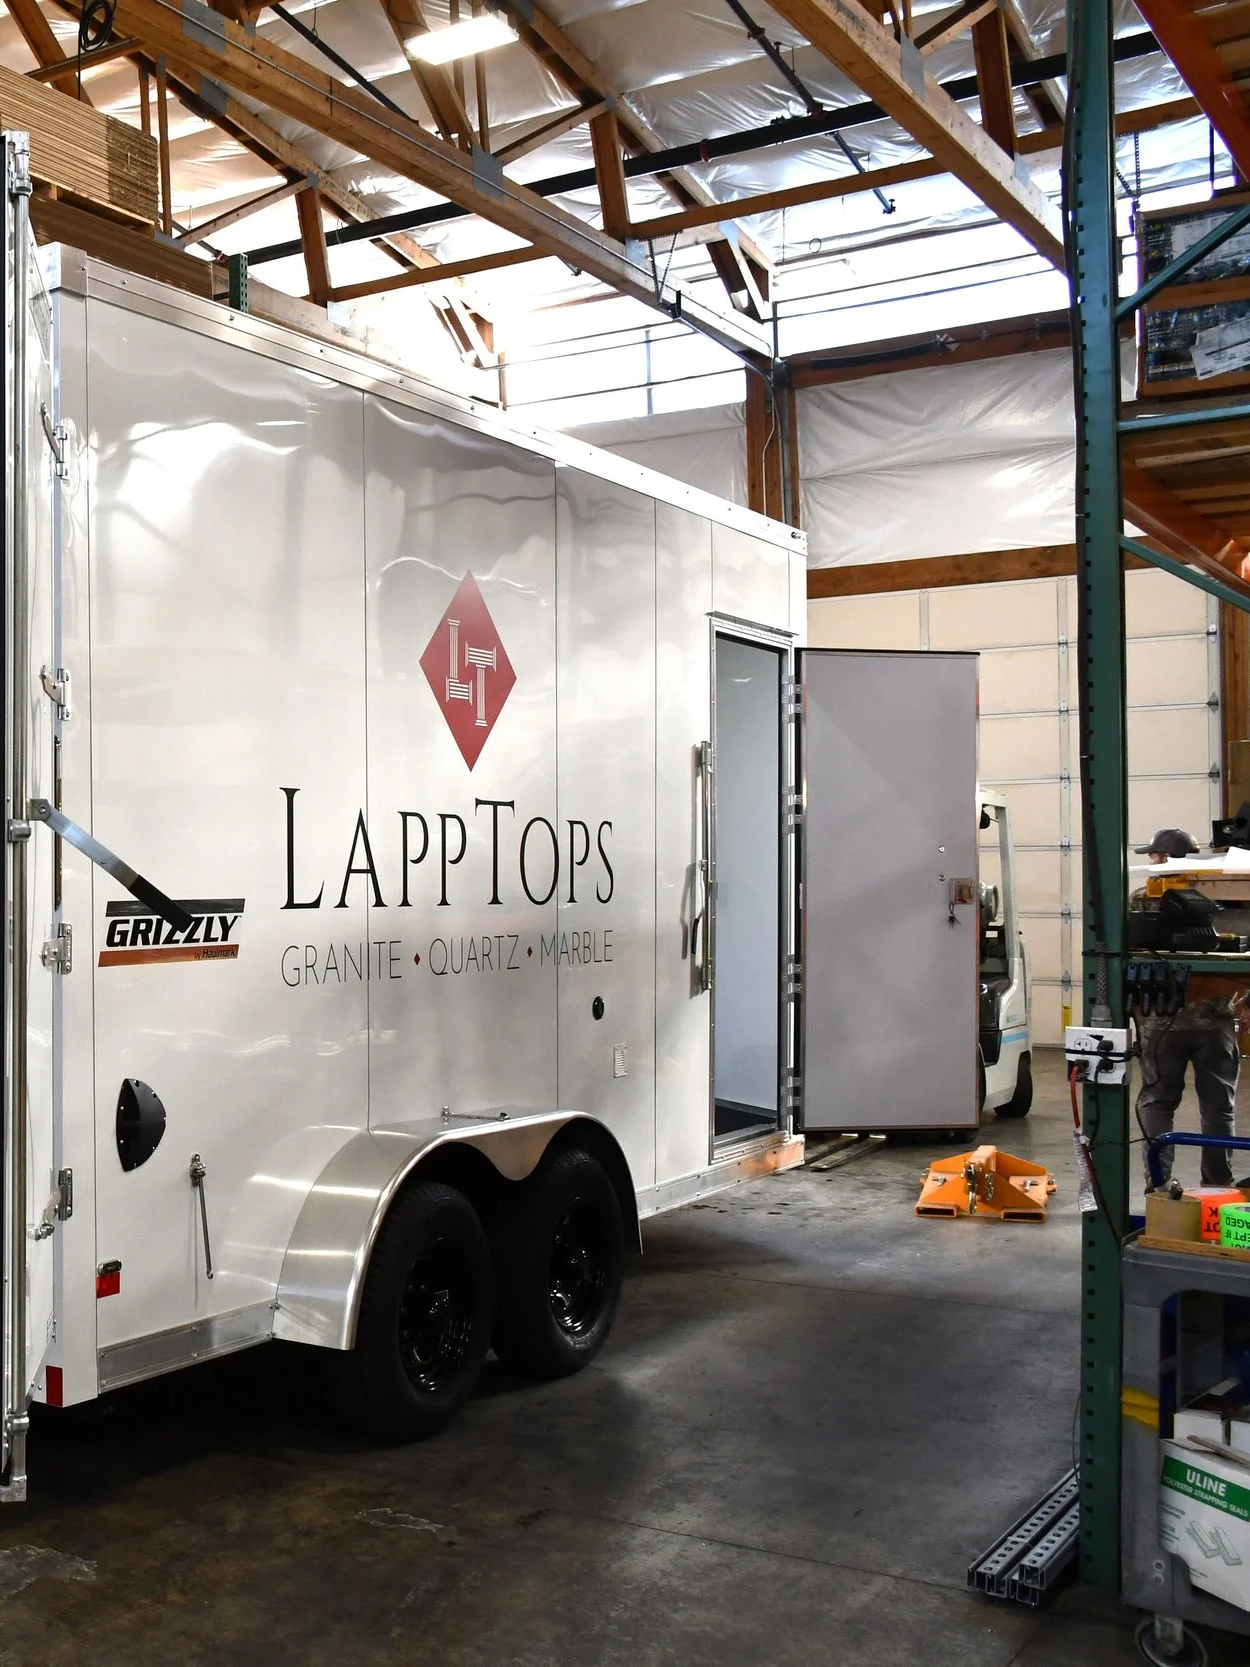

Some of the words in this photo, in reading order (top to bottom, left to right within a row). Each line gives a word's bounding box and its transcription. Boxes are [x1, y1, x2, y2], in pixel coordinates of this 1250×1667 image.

[106, 915, 238, 948] GRIZZLY
[202, 948, 236, 959] Haulmark
[280, 940, 402, 987] GRANITE
[428, 933, 520, 976] QUARTZ
[540, 929, 614, 967] MARBLE
[1204, 1222, 1221, 1233] OT
[1225, 1217, 1250, 1229] AGED
[1234, 1230, 1250, 1242] EPT
[1186, 1469, 1227, 1497] ULINE
[1194, 1488, 1228, 1509] STRAPPING
[1229, 1503, 1248, 1517] SEALS
